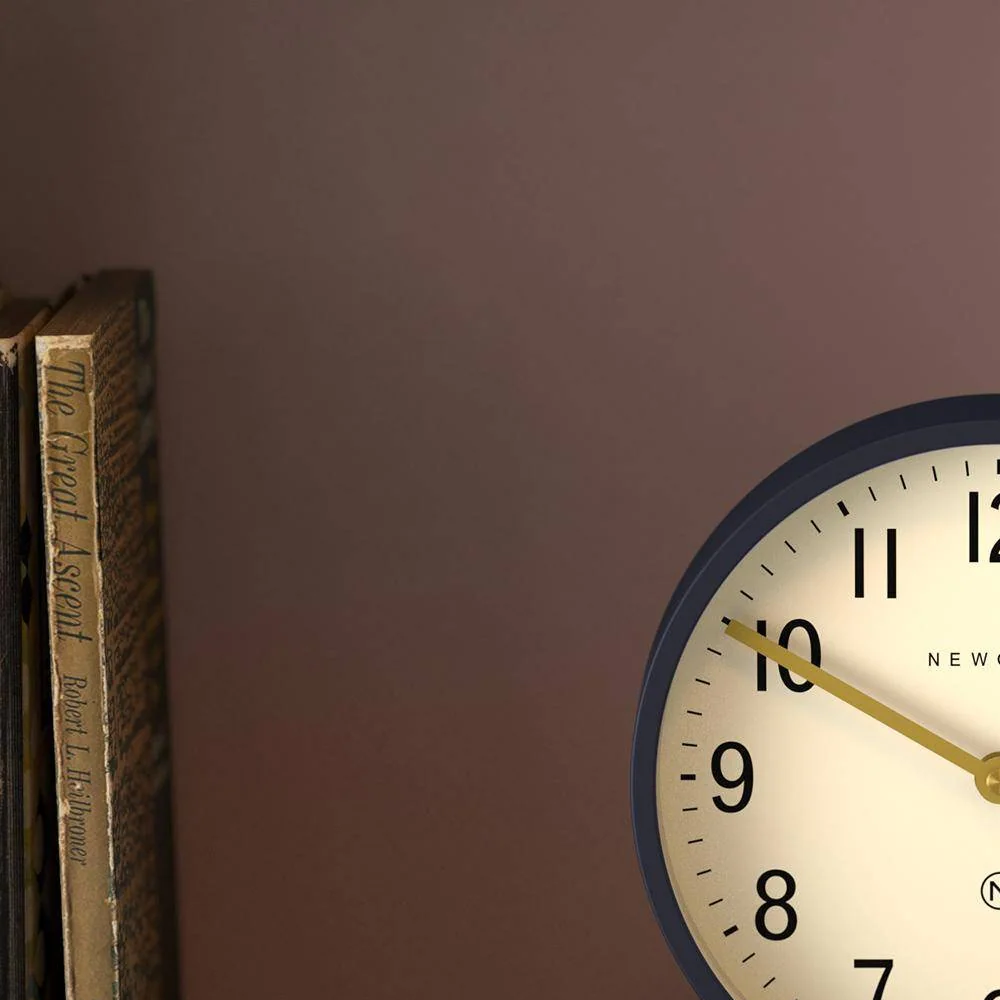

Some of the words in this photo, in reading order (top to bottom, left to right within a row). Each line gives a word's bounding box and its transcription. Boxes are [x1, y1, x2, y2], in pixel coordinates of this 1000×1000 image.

[46, 361, 86, 416] The
[48, 430, 89, 522] Great
[52, 538, 93, 643] Ascent
[855, 528, 896, 598] 11
[756, 619, 821, 692] 10
[63, 674, 88, 735] Robert
[66, 743, 90, 761] L.
[711, 742, 753, 813] 9
[67, 768, 92, 866] Heilbroner
[755, 870, 797, 941] 8
